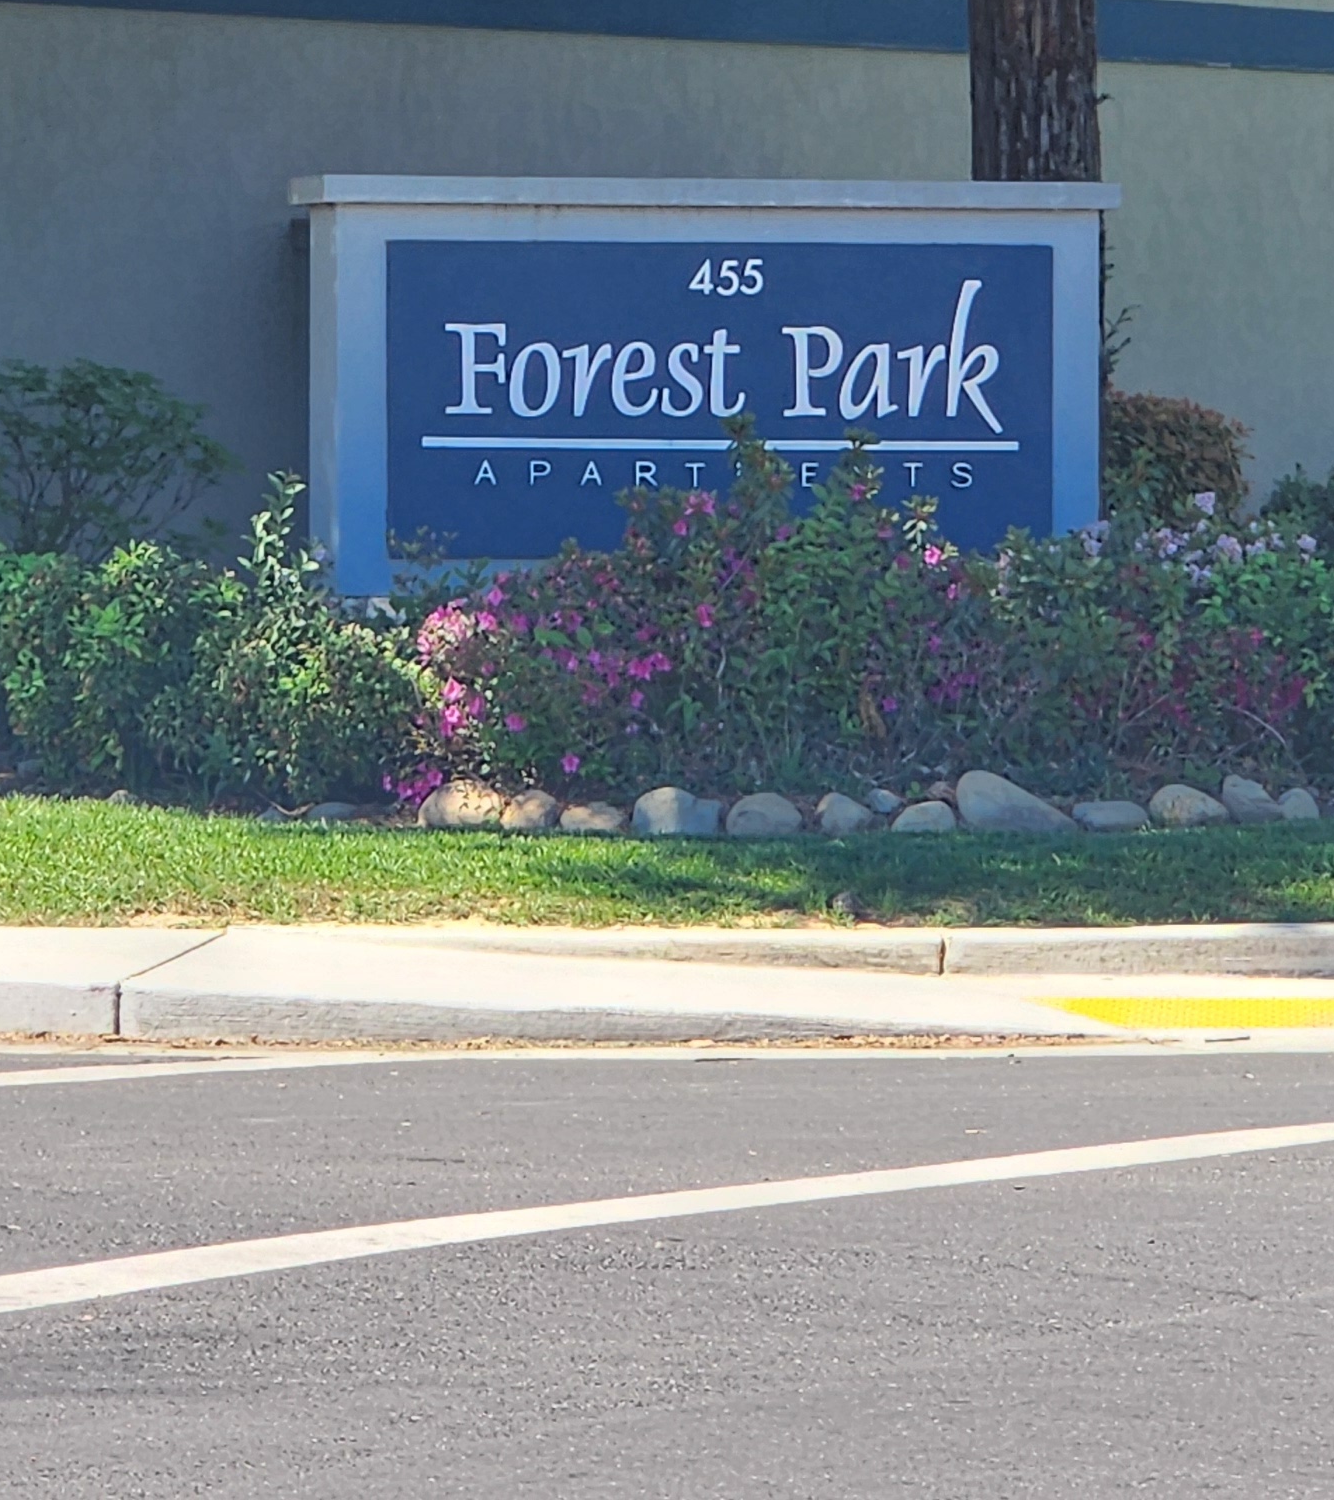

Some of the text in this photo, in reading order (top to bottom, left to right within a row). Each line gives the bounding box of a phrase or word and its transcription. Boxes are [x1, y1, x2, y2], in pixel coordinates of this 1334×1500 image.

[688, 258, 764, 296] 455
[444, 279, 1003, 434] Forest Park
[473, 460, 973, 487] APARTETS
